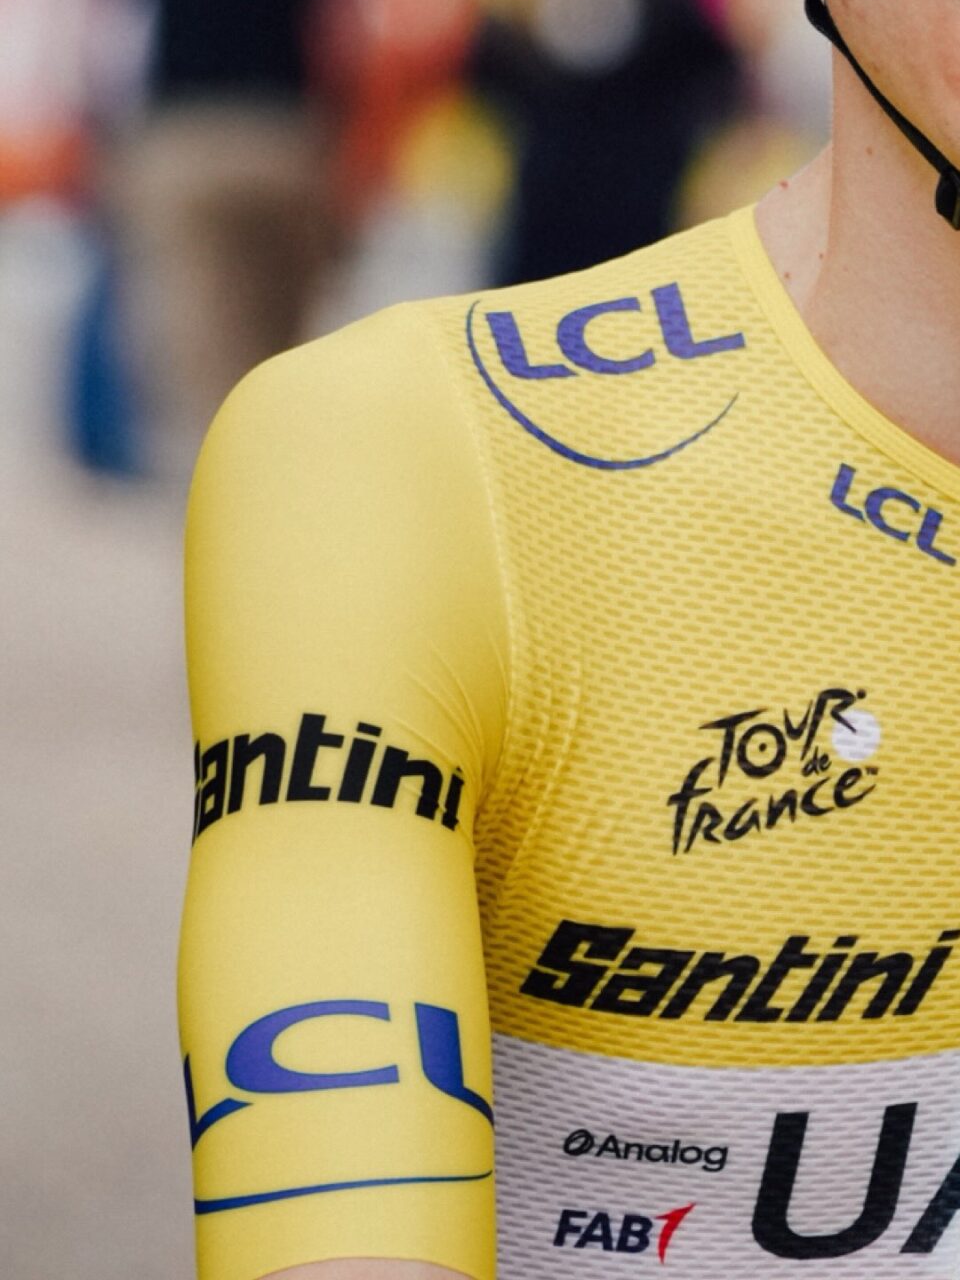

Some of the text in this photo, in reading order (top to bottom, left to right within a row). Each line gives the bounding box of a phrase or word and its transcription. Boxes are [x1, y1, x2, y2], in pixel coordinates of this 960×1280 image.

[485, 282, 746, 380] LCL
[830, 463, 957, 567] LCL
[192, 713, 465, 848] antini
[801, 746, 832, 778] de
[594, 1134, 729, 1173] Analog
